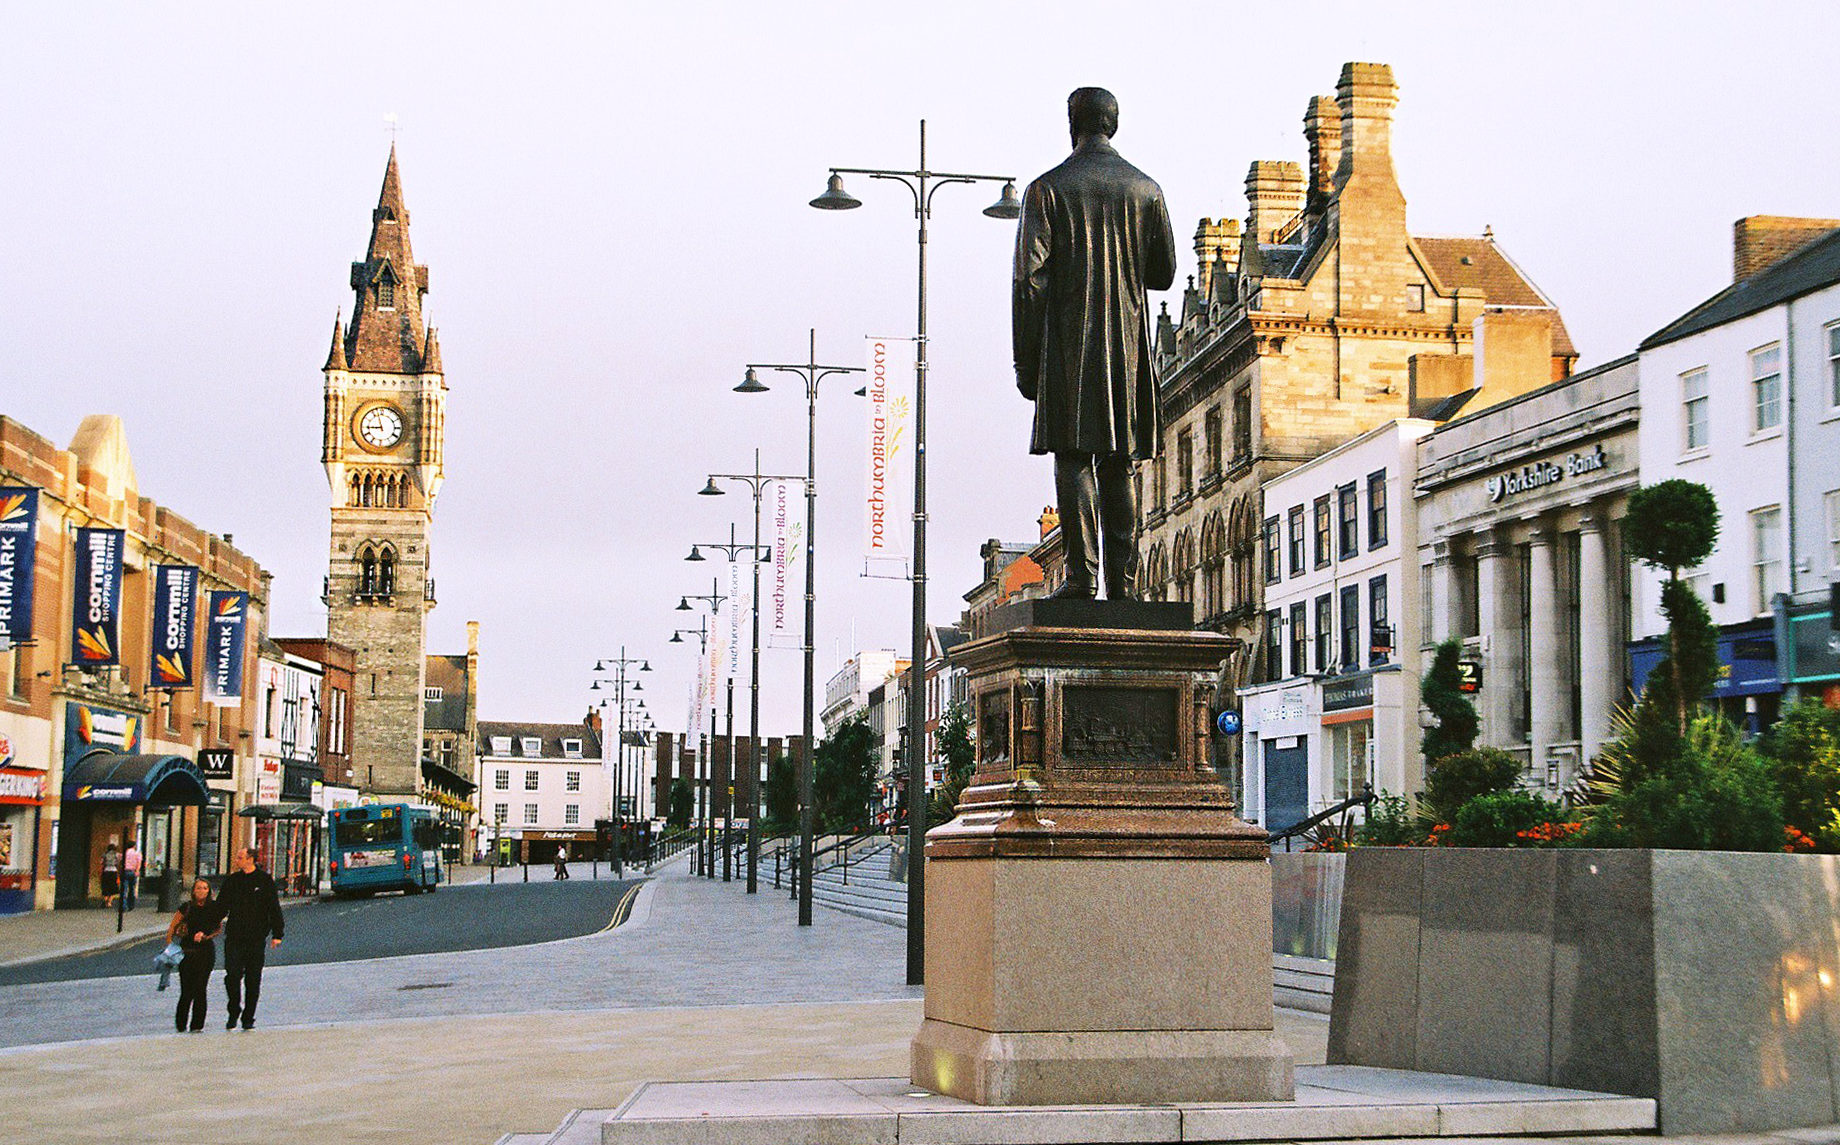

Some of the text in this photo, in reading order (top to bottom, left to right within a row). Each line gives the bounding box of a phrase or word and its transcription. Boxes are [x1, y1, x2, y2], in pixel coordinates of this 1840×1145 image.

[1503, 447, 1604, 495] Yorkshire Bank
[0, 536, 15, 634] PRIMARK
[88, 532, 107, 623] cornmill
[101, 534, 116, 622] SHOPPING CENTRE
[166, 569, 183, 650] cornmill
[178, 570, 191, 649] SHOPPING CENTRE
[217, 626, 232, 695] PRIMARK
[207, 754, 227, 769] W
